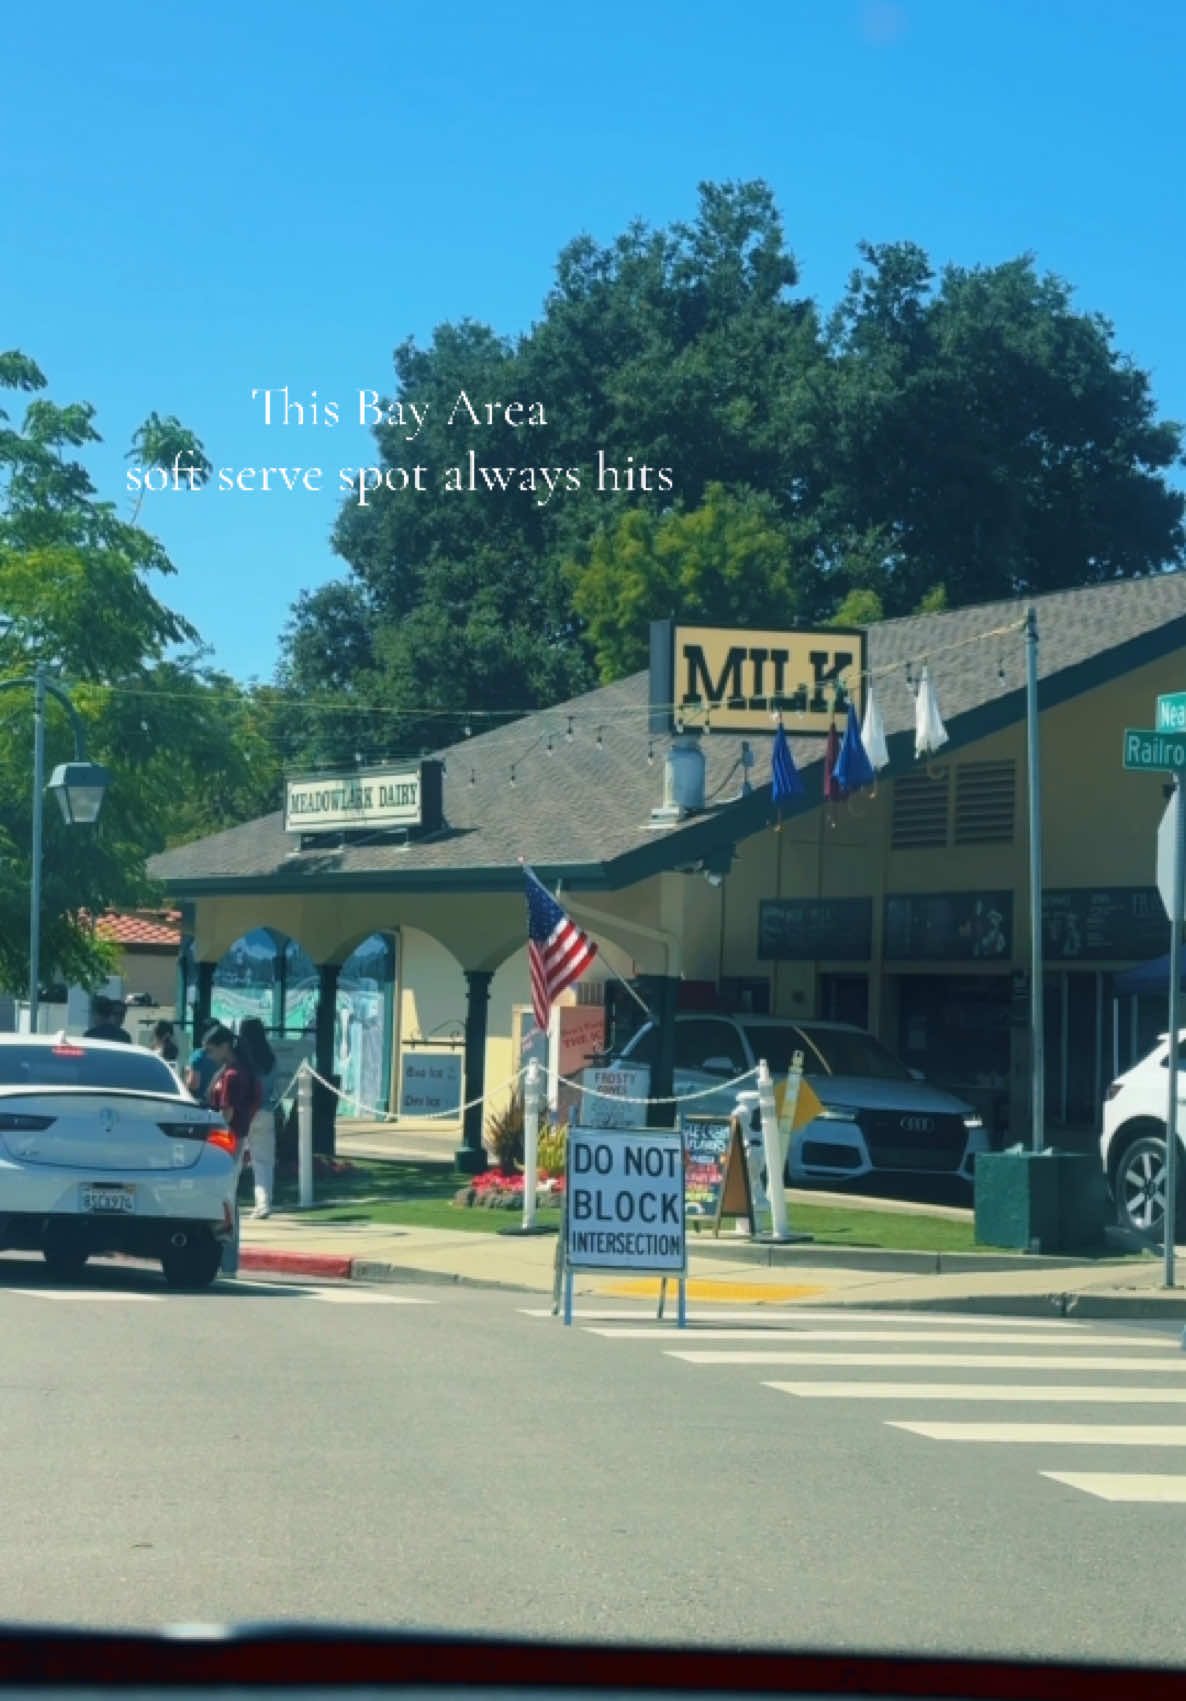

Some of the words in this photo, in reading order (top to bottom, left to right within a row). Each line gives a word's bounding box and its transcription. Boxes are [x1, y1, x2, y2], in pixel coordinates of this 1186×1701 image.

[682, 644, 853, 713] MILK
[289, 786, 374, 814] MEADOWLARK
[379, 783, 419, 808] DAIRY
[594, 1071, 638, 1084] FROSTY
[574, 1143, 614, 1175] DO
[624, 1146, 680, 1177] NOT
[574, 1190, 680, 1224] BLOCK
[572, 1231, 680, 1256] INTERSECTION
